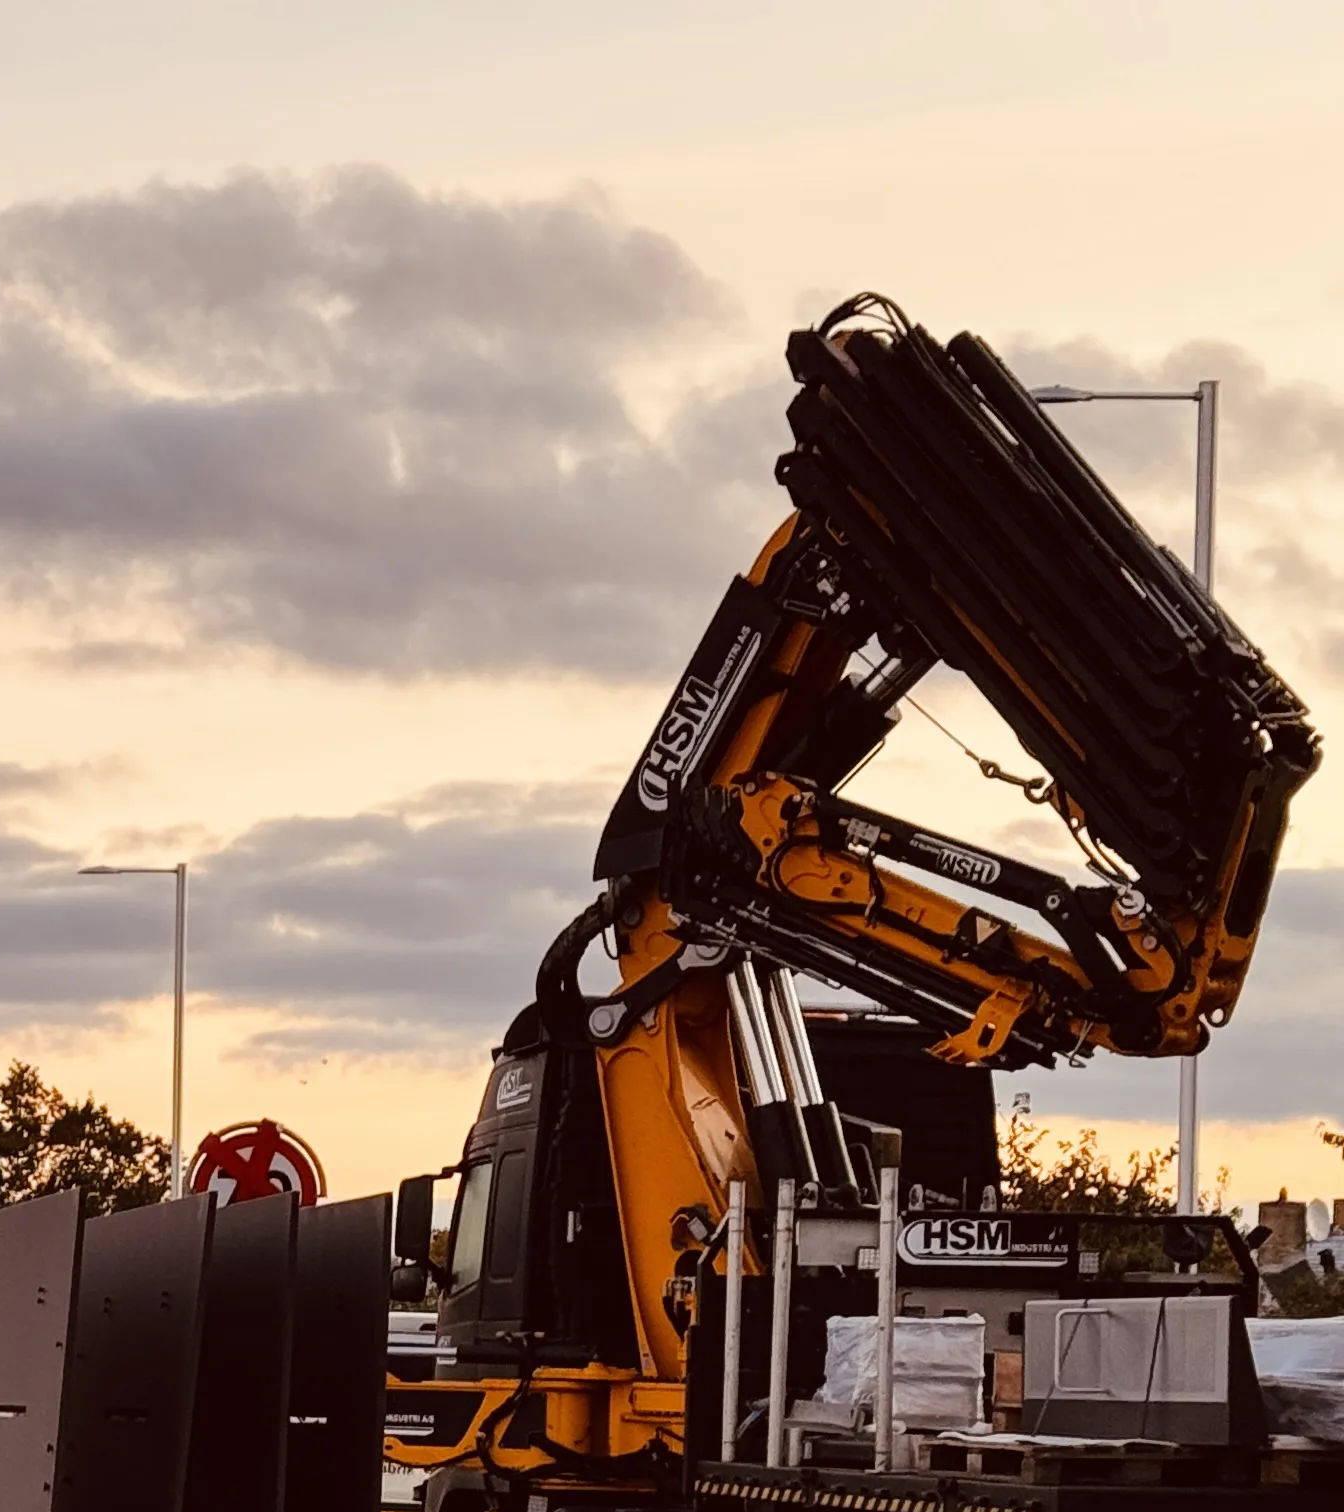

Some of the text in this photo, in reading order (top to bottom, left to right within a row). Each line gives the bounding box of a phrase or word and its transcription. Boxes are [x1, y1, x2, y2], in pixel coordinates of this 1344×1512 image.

[646, 680, 717, 779] HSM
[937, 848, 987, 882] HSM
[923, 1220, 1011, 1251] HSM
